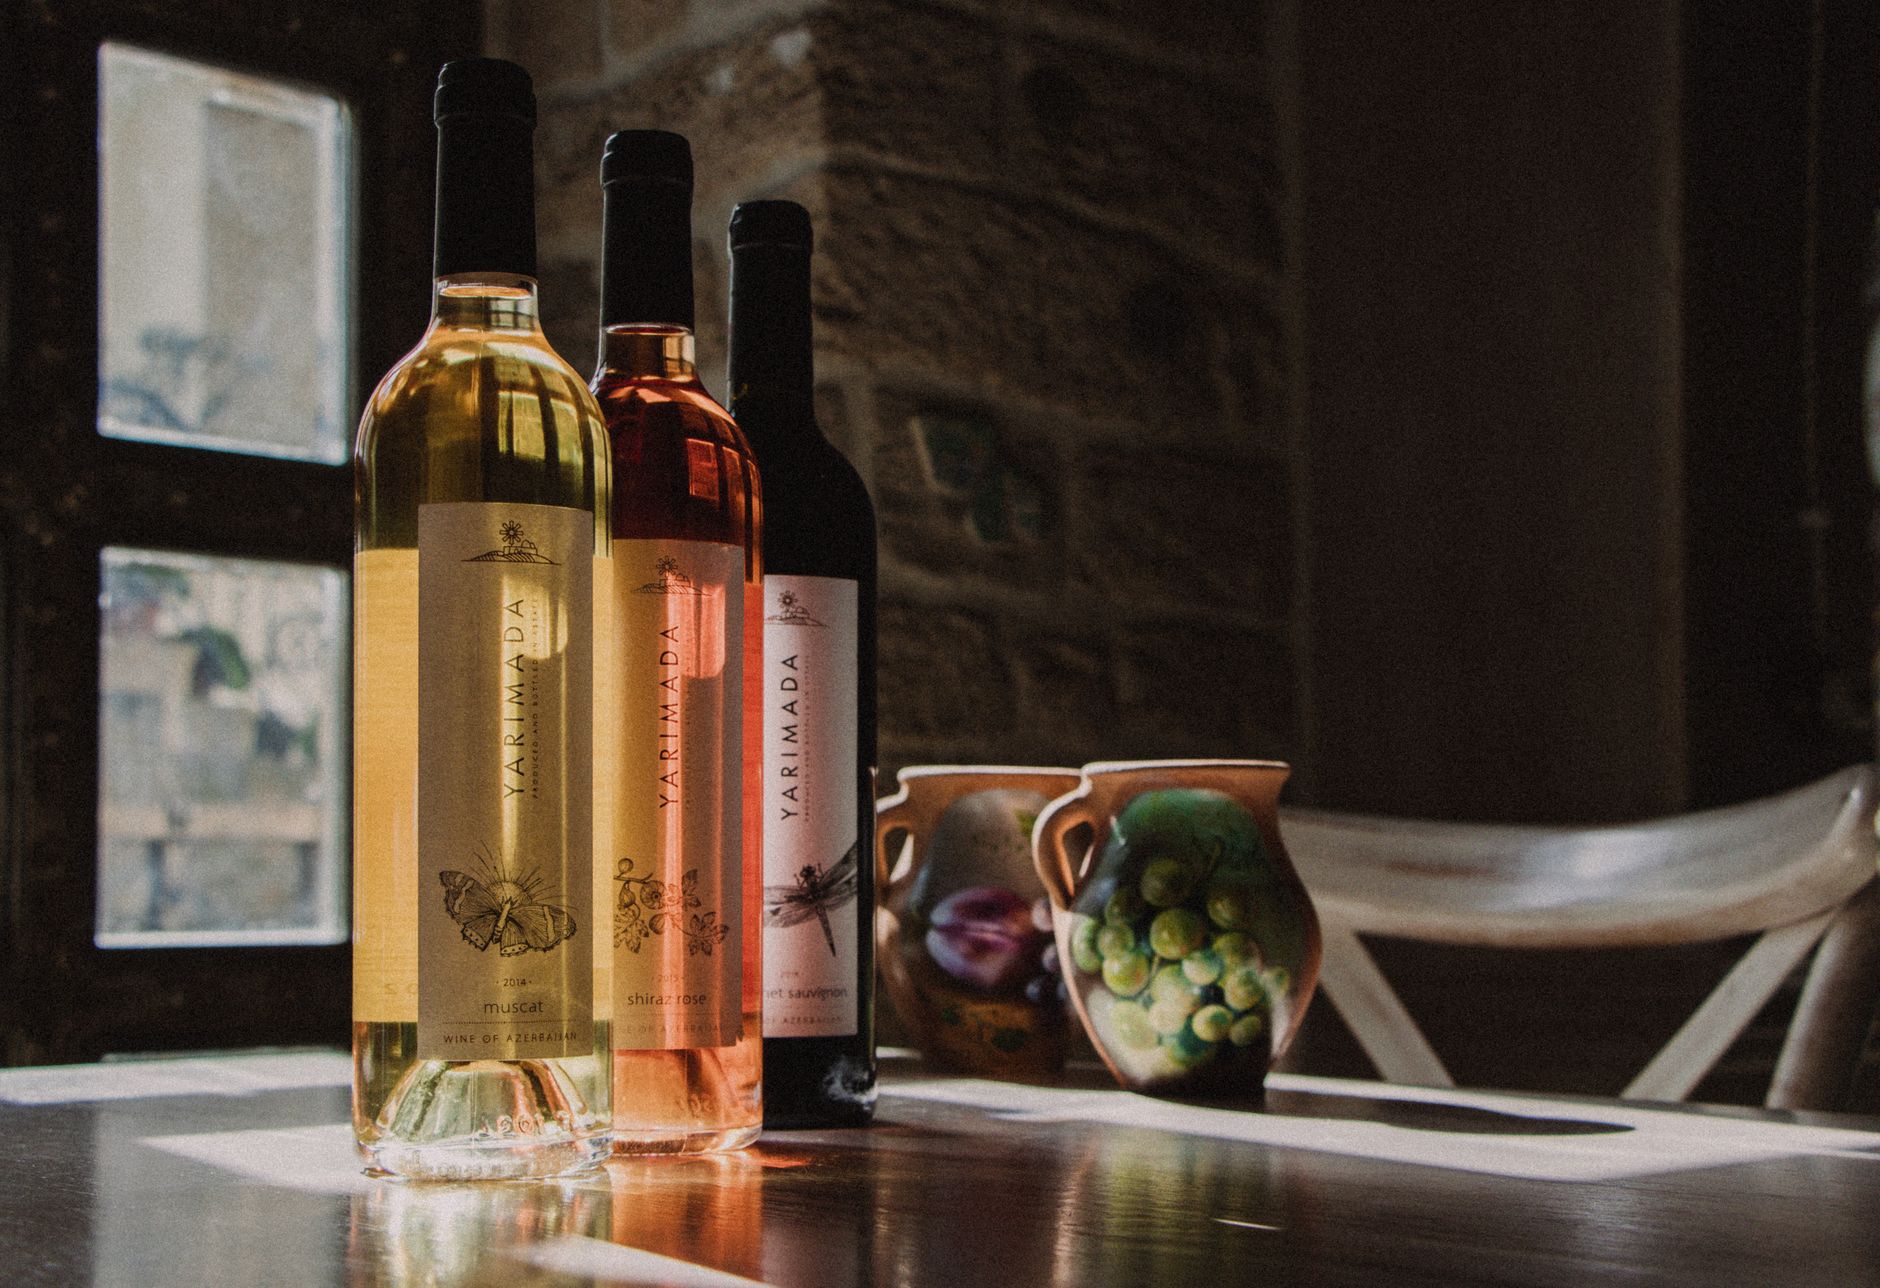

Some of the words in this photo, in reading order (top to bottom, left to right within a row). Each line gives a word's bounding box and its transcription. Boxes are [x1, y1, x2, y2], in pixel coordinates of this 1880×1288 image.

[503, 599, 525, 799] YARIMADA
[532, 712, 540, 735] AND
[659, 625, 679, 809] YARIMADA
[781, 654, 799, 821] YARIMADA
[532, 741, 540, 800] PRODUCED
[503, 977, 527, 987] 2014
[627, 991, 672, 1006] shiraz
[677, 993, 707, 1005] rose
[788, 986, 848, 1001] sauvignon
[483, 999, 544, 1016] muscat
[442, 1034, 477, 1045] WINE
[482, 1034, 499, 1045] OF
